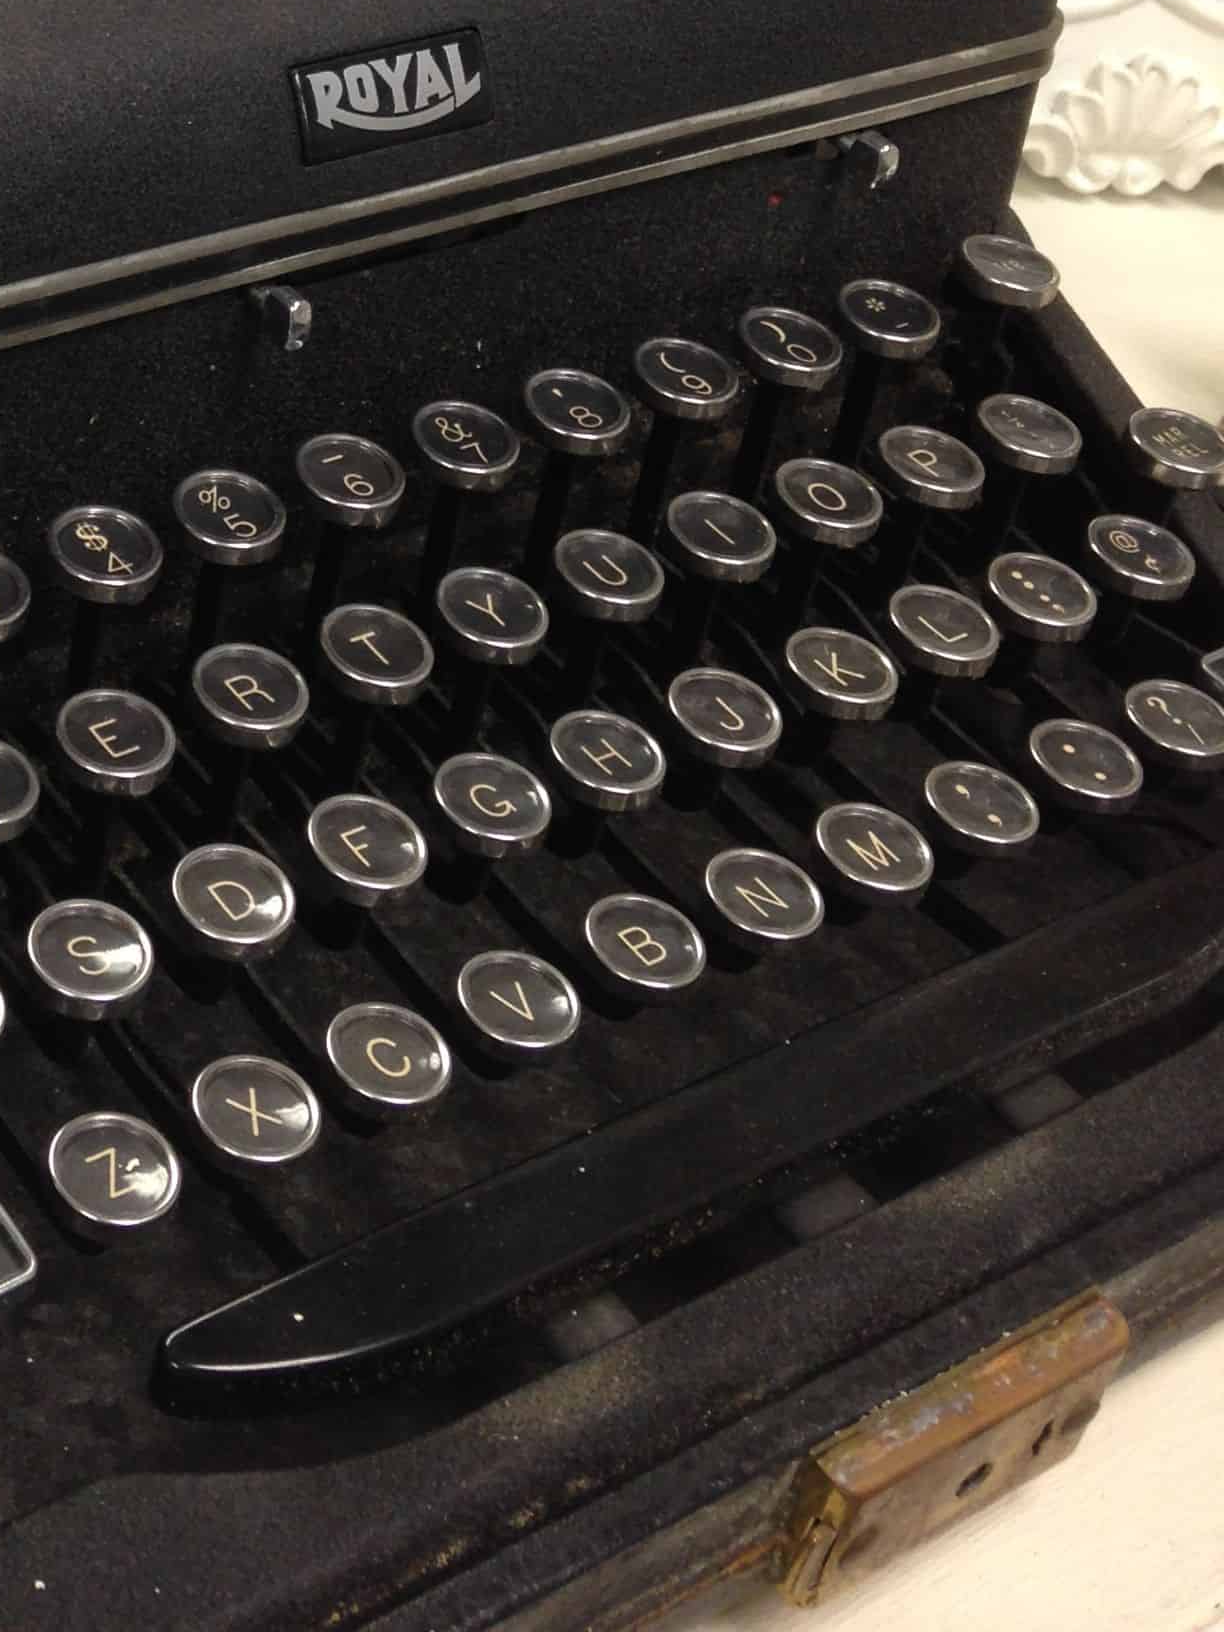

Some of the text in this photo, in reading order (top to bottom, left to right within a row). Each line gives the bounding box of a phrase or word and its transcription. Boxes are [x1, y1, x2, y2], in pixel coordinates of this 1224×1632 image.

[303, 42, 481, 131] ROYAL
[679, 373, 713, 395] 9
[434, 416, 472, 444] &
[568, 405, 603, 428] 8
[906, 449, 940, 478] P
[198, 484, 231, 513] %
[343, 473, 374, 497] 6
[75, 522, 109, 552] $
[223, 513, 257, 538] 5
[1108, 530, 1141, 554] @
[107, 551, 133, 575] 4
[582, 554, 628, 587] U
[465, 593, 505, 627] Y
[349, 630, 389, 665] T
[916, 615, 969, 647] L
[813, 651, 865, 686] K
[223, 674, 275, 711] R
[715, 696, 745, 731] J
[88, 717, 141, 758] E
[580, 738, 633, 776] H
[469, 783, 518, 817] G
[339, 825, 371, 867] F
[845, 830, 901, 871] M
[207, 880, 256, 921] D
[735, 876, 790, 918] N
[67, 935, 112, 975] S
[617, 926, 667, 967] B
[489, 981, 535, 1021] V
[366, 1037, 411, 1077] C
[225, 1087, 281, 1137] X
[85, 1147, 138, 1199] Z
